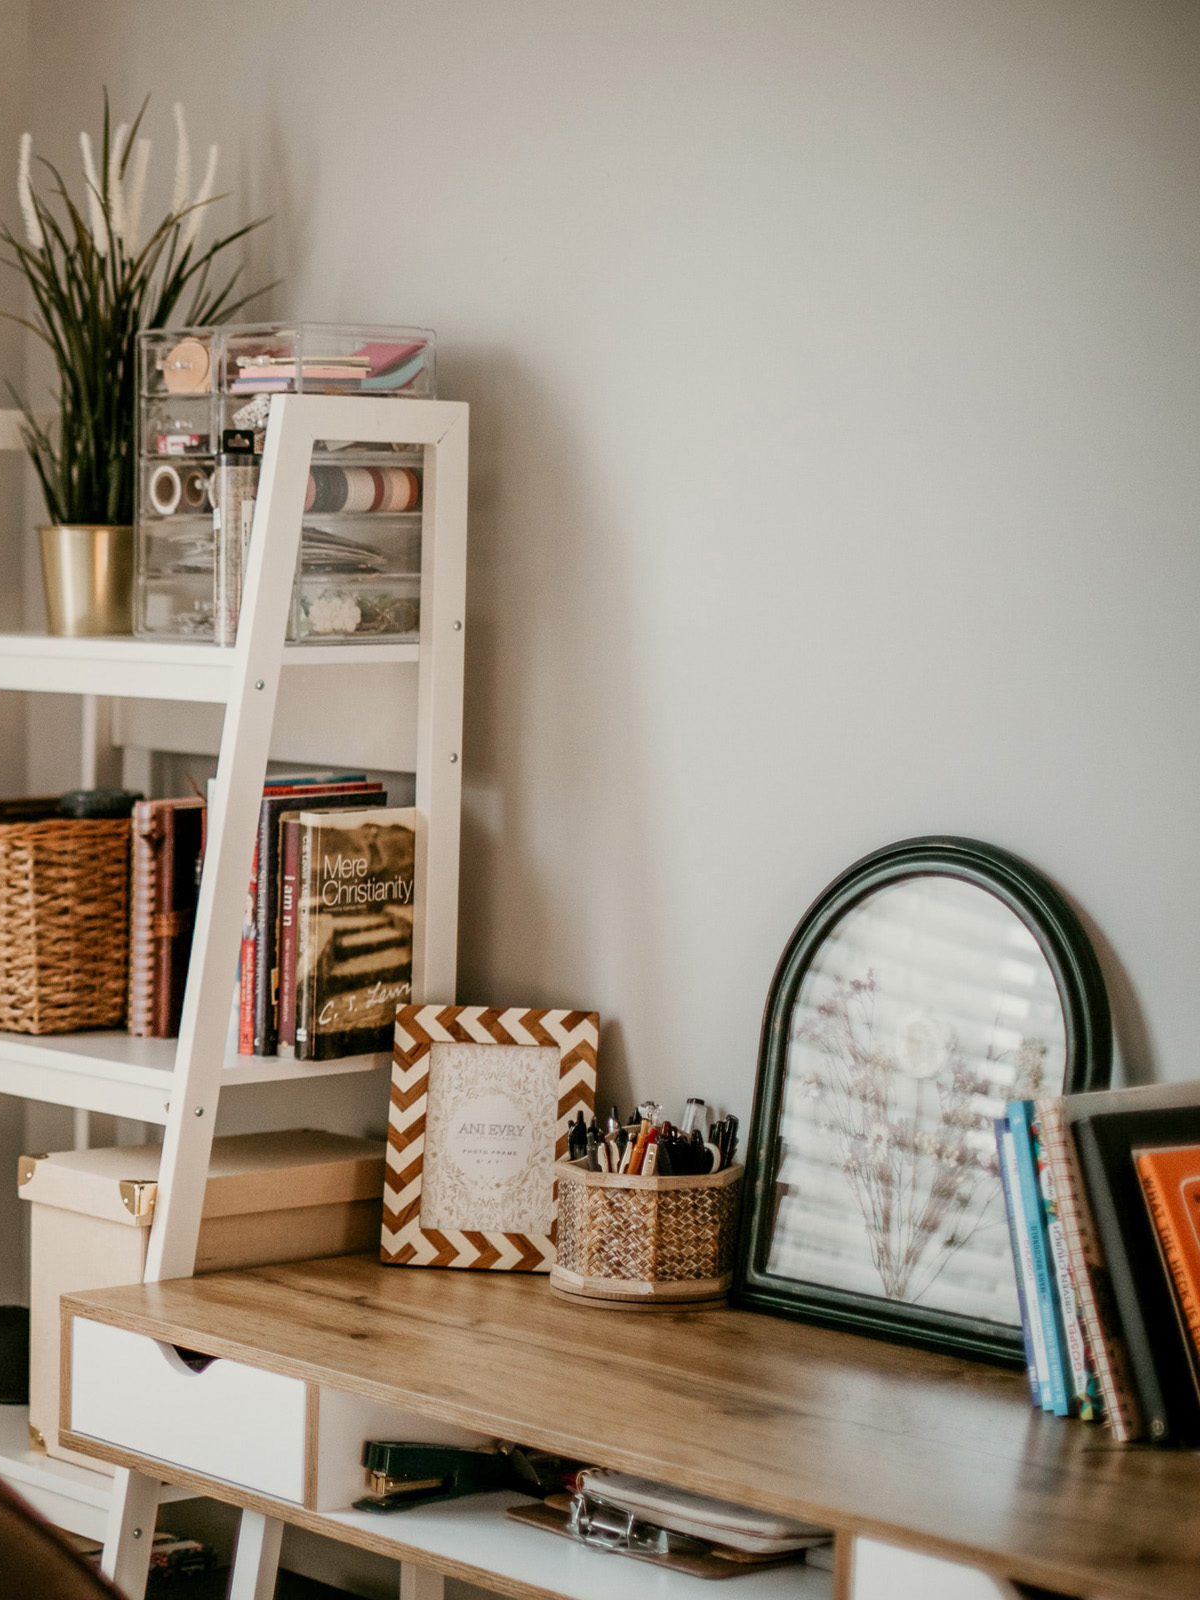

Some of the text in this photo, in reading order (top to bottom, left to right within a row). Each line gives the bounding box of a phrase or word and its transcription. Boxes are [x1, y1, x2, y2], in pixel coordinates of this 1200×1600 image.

[323, 854, 368, 880] Mere
[283, 885, 293, 911] am
[322, 875, 414, 906] Christianity
[282, 915, 292, 927] n
[1030, 1225, 1043, 1271] MACDONALD
[1053, 1225, 1066, 1271] CHURCH
[1142, 1177, 1164, 1218] WHAT
[1159, 1223, 1176, 1251] THE
[1170, 1260, 1191, 1298] HECK
[1038, 1272, 1048, 1294] MARK
